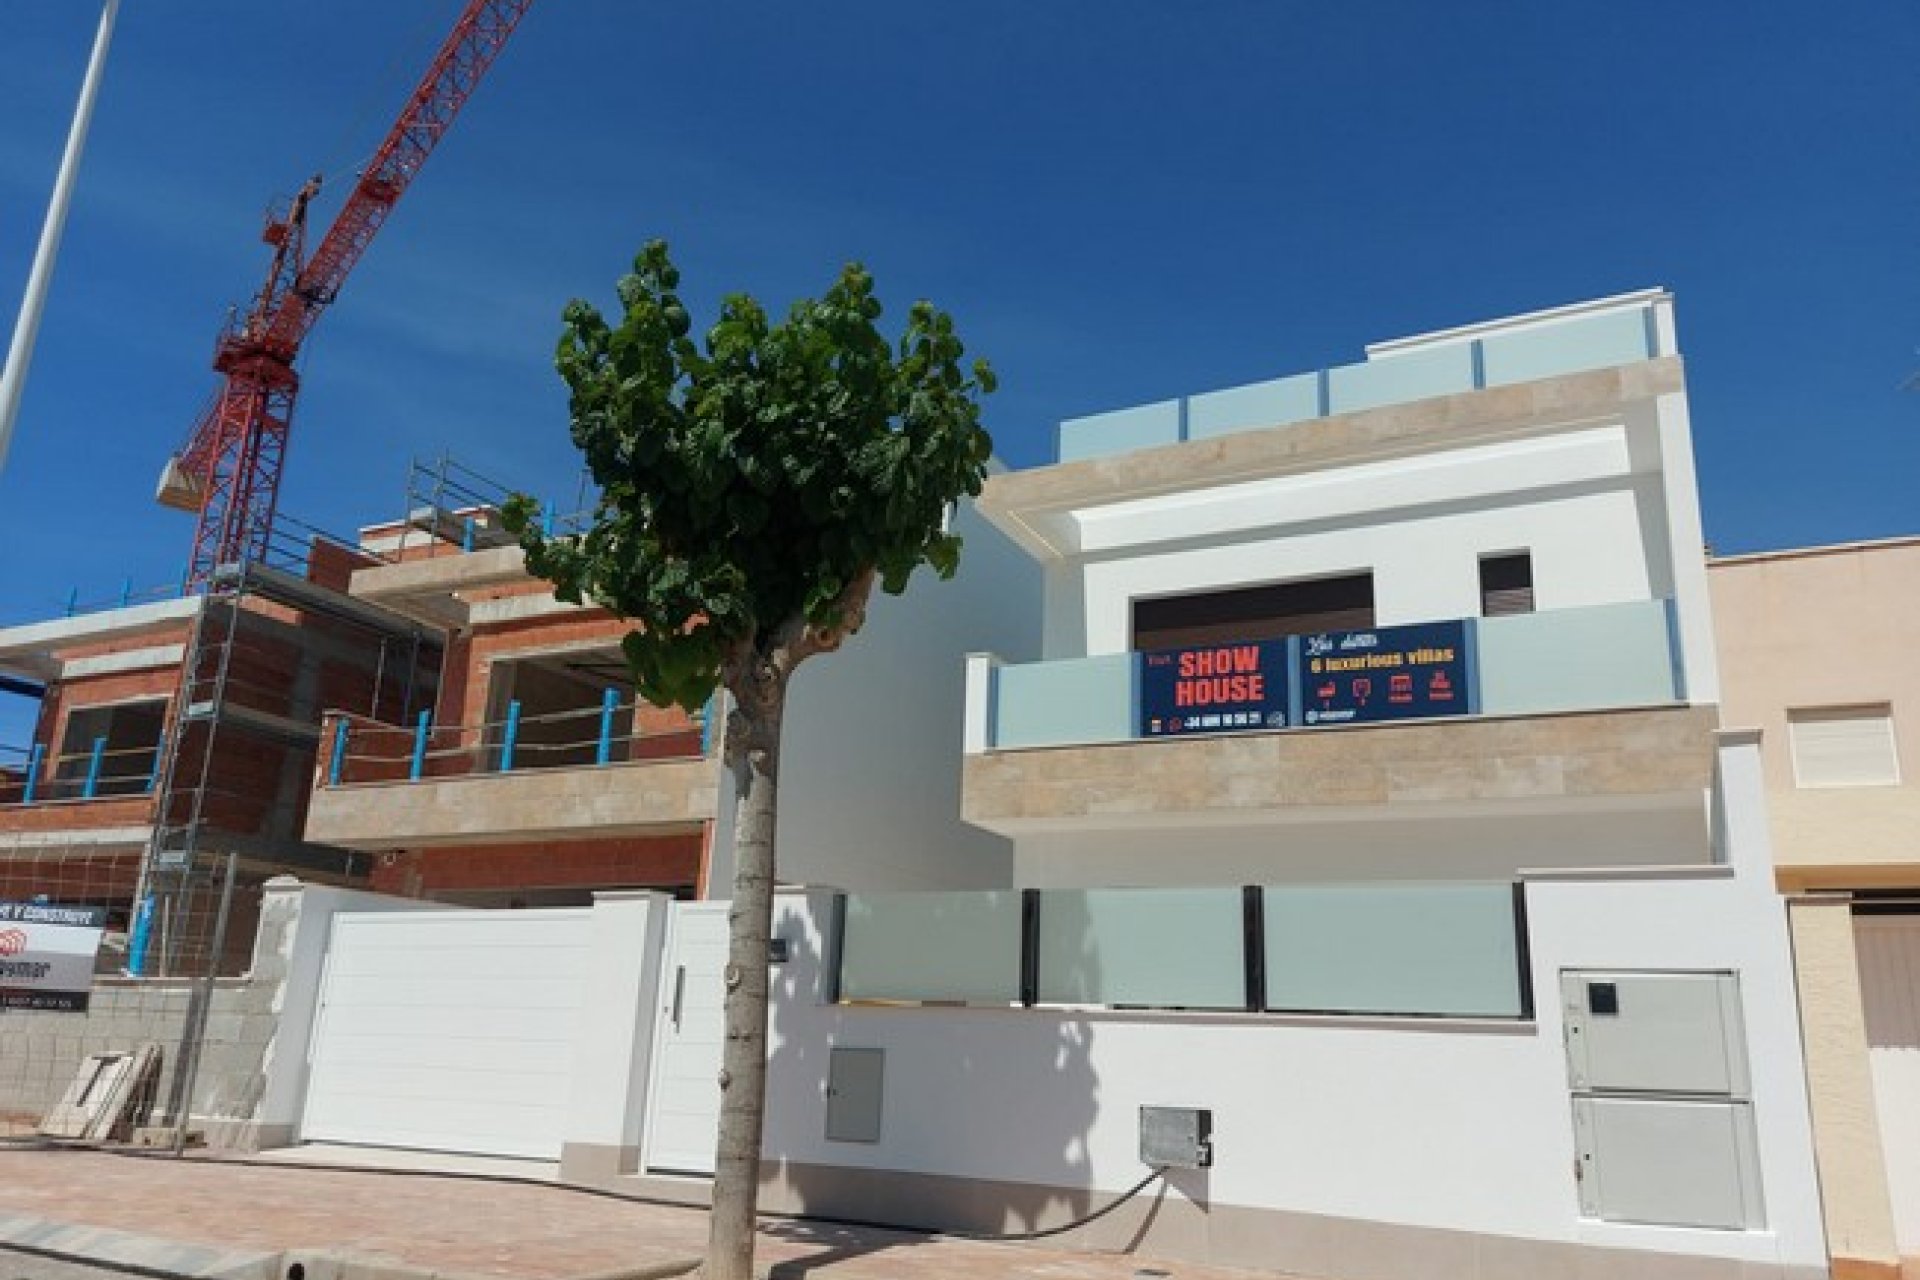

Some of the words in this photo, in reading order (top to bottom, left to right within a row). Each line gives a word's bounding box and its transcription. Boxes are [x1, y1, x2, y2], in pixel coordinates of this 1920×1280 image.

[1178, 645, 1259, 677] SHOW
[1325, 652, 1404, 673] luxurious
[1406, 648, 1455, 665] villas
[1174, 674, 1265, 707] HOUSE
